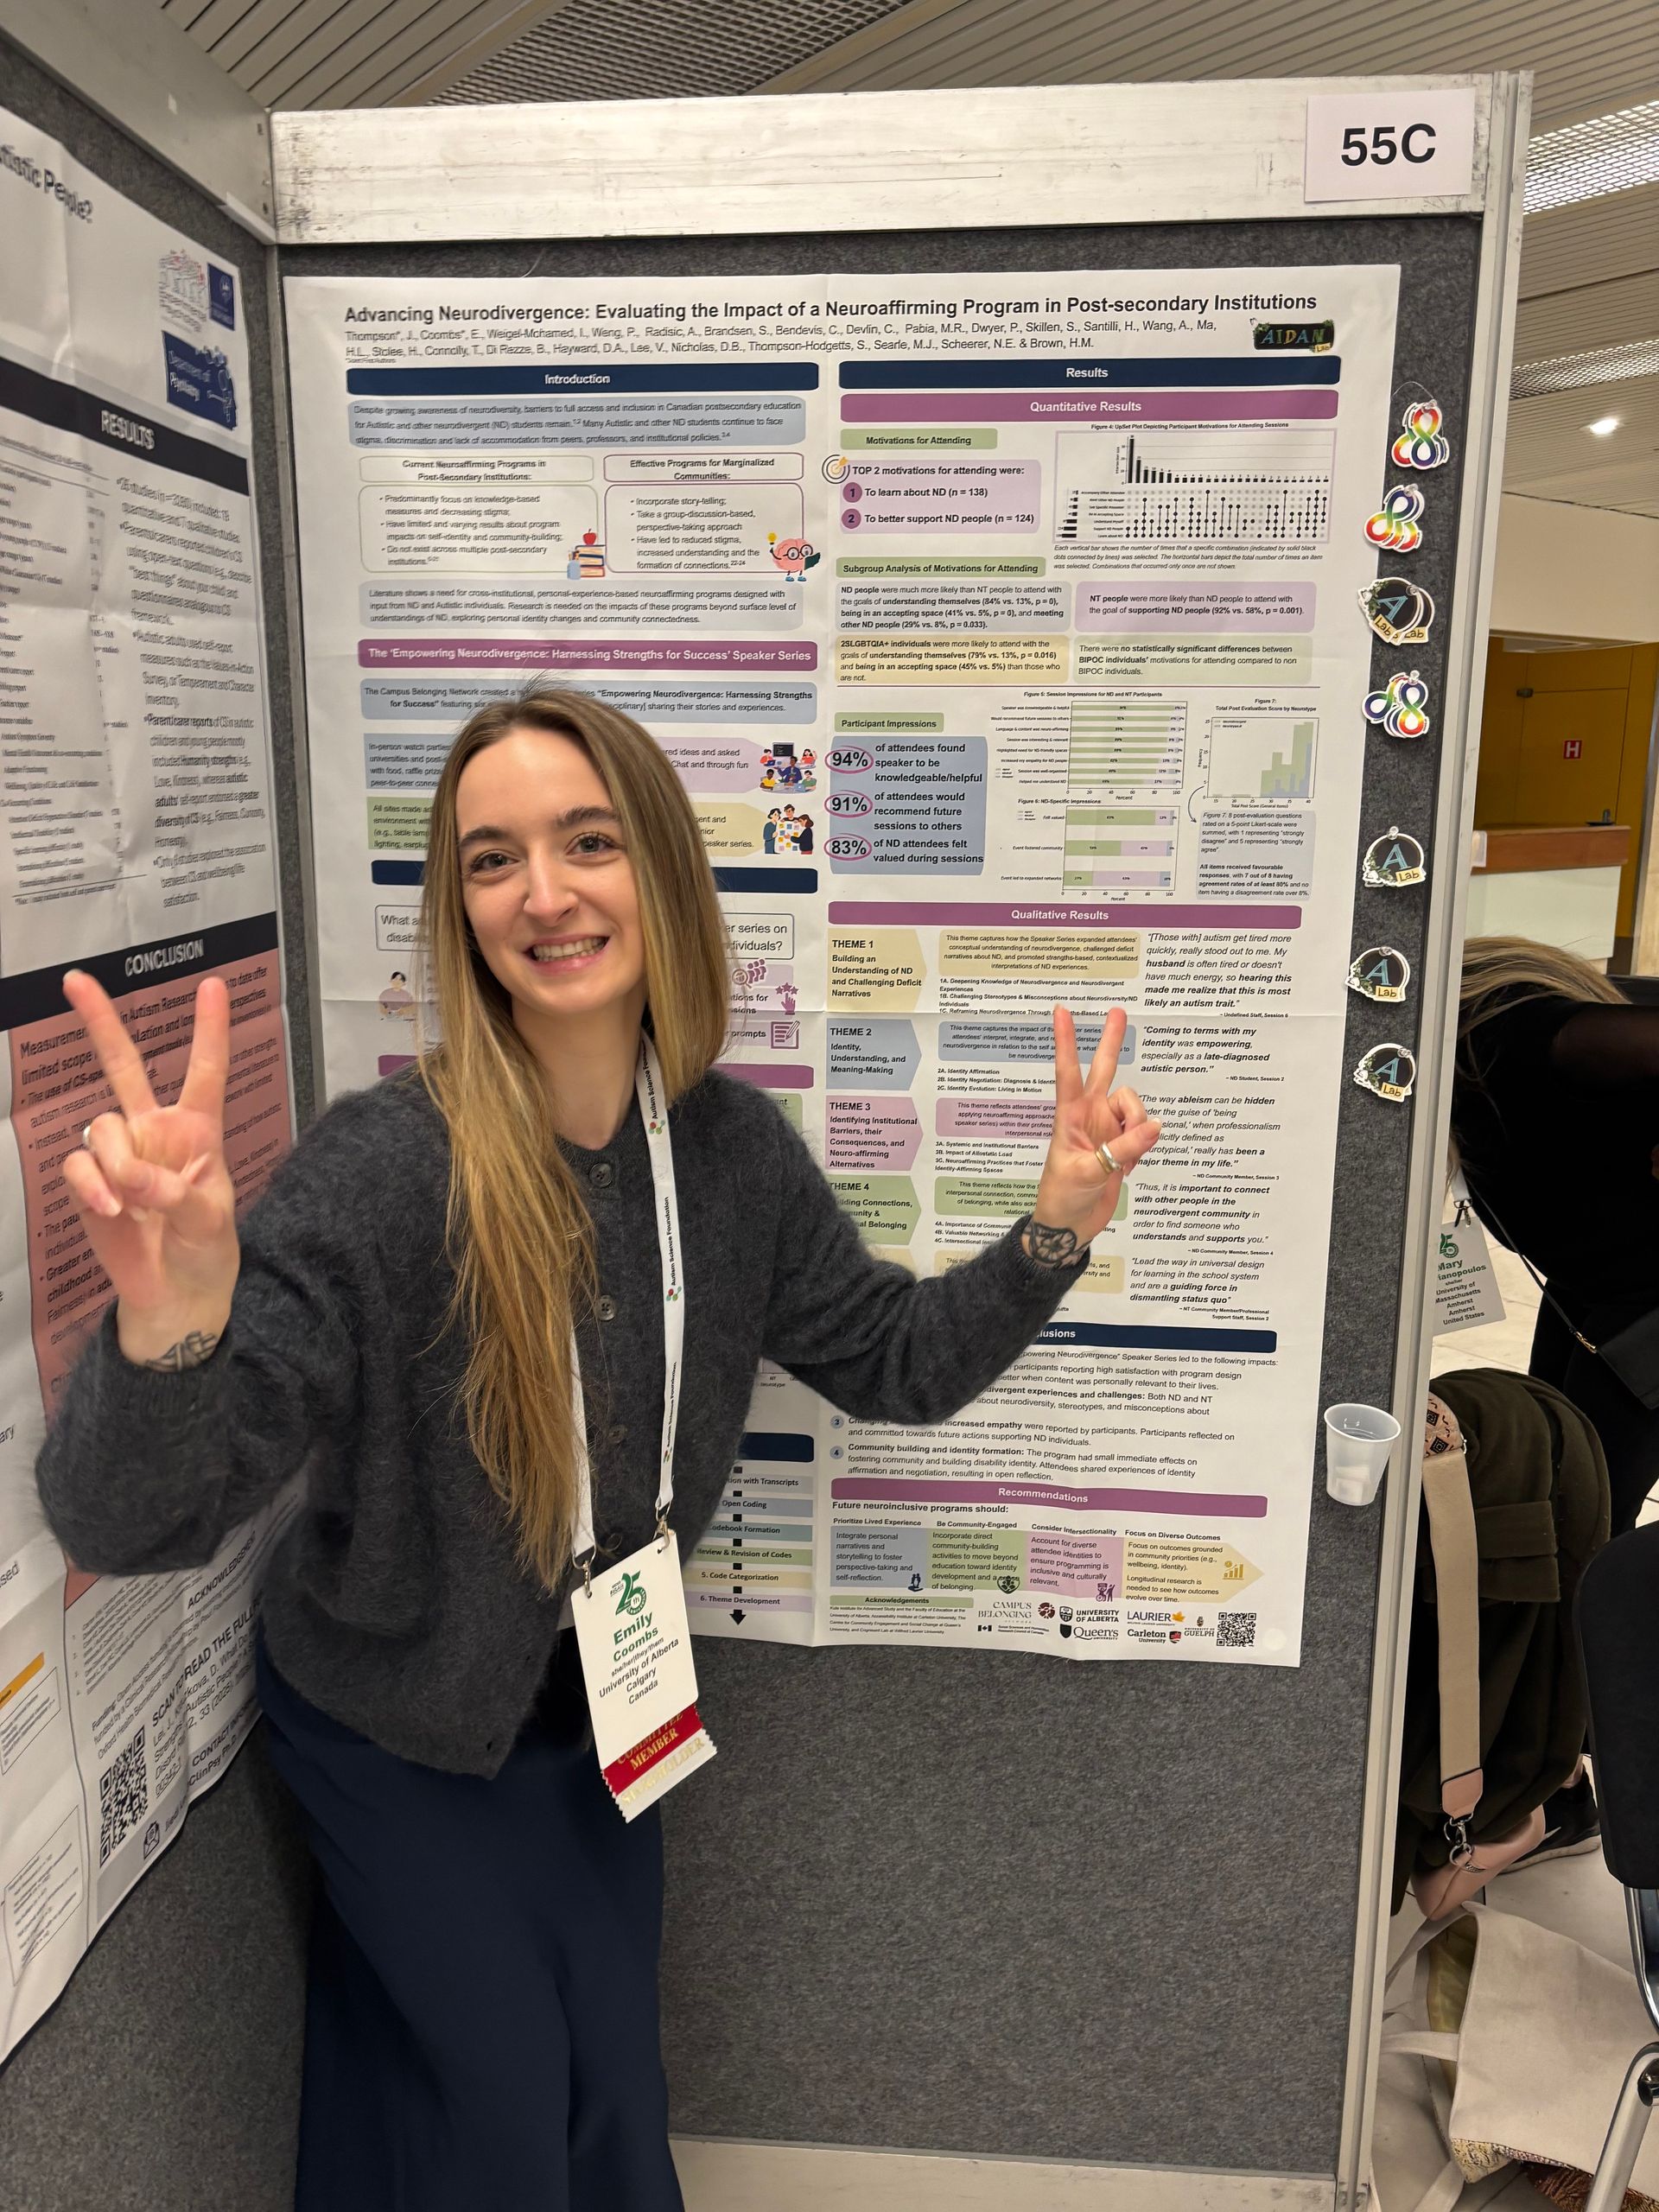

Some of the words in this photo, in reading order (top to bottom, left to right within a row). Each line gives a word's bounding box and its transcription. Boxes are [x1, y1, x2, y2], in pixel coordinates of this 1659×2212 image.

[1341, 123, 1436, 166] 55C
[345, 306, 433, 325] Advancing
[439, 305, 589, 323] Neurodivergence:
[596, 303, 685, 321] Evaluating
[691, 303, 718, 317] the
[724, 302, 783, 320] Impact
[788, 301, 806, 316] of
[810, 305, 819, 316] a
[826, 299, 957, 318] Neuroaffirming
[963, 299, 1039, 318] Program
[1045, 297, 1060, 312] in
[1067, 295, 1209, 314] Post-secondary
[1214, 293, 1316, 310] Institutions
[1262, 329, 1325, 344] AIDAN
[1066, 367, 1108, 377] Results
[545, 373, 610, 384] Introduction
[1030, 401, 1097, 412] Quantitative
[1100, 401, 1141, 411] Results
[101, 410, 155, 449] RESULTS
[930, 436, 971, 446] Attending
[852, 466, 872, 475] TOP
[874, 466, 880, 474] 2
[882, 466, 936, 475] motivations
[938, 466, 952, 474] for
[953, 466, 997, 476] attending
[850, 488, 855, 497] 1
[864, 488, 876, 496] To
[878, 488, 901, 496] learn
[903, 488, 930, 496] about
[932, 488, 946, 496] ND
[948, 488, 958, 498] (n
[968, 488, 988, 498] 138)
[848, 514, 855, 523] 2
[864, 514, 876, 522] To
[878, 514, 905, 522] better
[906, 515, 943, 524] support
[945, 514, 959, 522] ND
[961, 514, 992, 524] people
[995, 514, 1004, 524] (n
[1014, 514, 1034, 524] 124)
[1376, 596, 1408, 624] A
[1375, 617, 1390, 636] Lab
[368, 648, 387, 657] The
[457, 648, 549, 660] Neurodivergence:
[552, 649, 610, 661] Harnessing
[613, 649, 663, 661] Strengths
[666, 649, 681, 659] for
[732, 650, 776, 662] Speaker
[777, 650, 811, 660] Series
[841, 719, 885, 729] Participant
[887, 720, 936, 729] Impressions
[875, 743, 885, 752] of
[887, 743, 934, 752] attendees
[937, 743, 965, 752] found
[1566, 742, 1579, 757] H
[832, 752, 868, 766] 94%
[875, 758, 913, 768] speaker
[915, 759, 925, 767] to
[928, 758, 940, 767] be
[875, 773, 982, 784] knowledgeable/helpful
[874, 791, 885, 800] of
[886, 792, 933, 800] attendees
[936, 792, 965, 801] would
[831, 797, 868, 812] 91%
[874, 807, 931, 815] recommend
[933, 807, 962, 815] future
[873, 821, 916, 830] sessions
[931, 822, 962, 830] others
[831, 840, 867, 855] 83%
[873, 838, 884, 847] of
[886, 839, 900, 847] ND
[902, 839, 949, 848] attendees
[952, 839, 967, 848] felt
[873, 853, 905, 862] valued
[907, 854, 938, 864] during
[940, 854, 984, 863] sessions
[1383, 844, 1411, 870] A
[1398, 871, 1419, 881] Lab
[1011, 909, 1067, 919] Qualitative
[1069, 910, 1109, 920] Results
[831, 939, 866, 948] THEME
[868, 940, 873, 948] 1
[125, 939, 204, 976] CONCLUSION
[832, 954, 864, 964] Building
[832, 966, 889, 976] Understanding
[1365, 959, 1392, 986] A
[848, 978, 894, 987] Challenging
[1378, 989, 1397, 998] Lab
[829, 1027, 864, 1036] THEME
[1141, 1039, 1175, 1048] identity
[1196, 1040, 1252, 1049] empowering,
[1438, 1260, 1462, 1271] Mary
[1436, 1284, 1467, 1295] University
[1435, 1289, 1481, 1304] Massachusetts
[1447, 1298, 1473, 1308] Amherst
[1449, 1306, 1475, 1316] Amherst
[1443, 1316, 1463, 1325] United
[1465, 1312, 1484, 1320] States
[998, 1487, 1088, 1502] Recommendations
[863, 1502, 928, 1511] neuroinclusive
[930, 1505, 973, 1513] programs
[728, 1573, 779, 1581] Categorization
[1127, 1611, 1171, 1622] LAURIER
[613, 1612, 652, 1645] Emily
[1074, 1627, 1119, 1640] Queen's
[1127, 1628, 1166, 1637] Carleton
[613, 1627, 658, 1662] Coombs
[184, 1647, 211, 1681] READ
[212, 1627, 232, 1652] THE
[599, 1666, 639, 1698] University
[641, 1659, 649, 1669] of
[651, 1638, 679, 1662] Alberta
[626, 1668, 656, 1692] Calgary
[629, 1679, 658, 1704] Canada
[629, 1728, 679, 1770] MEMBER
